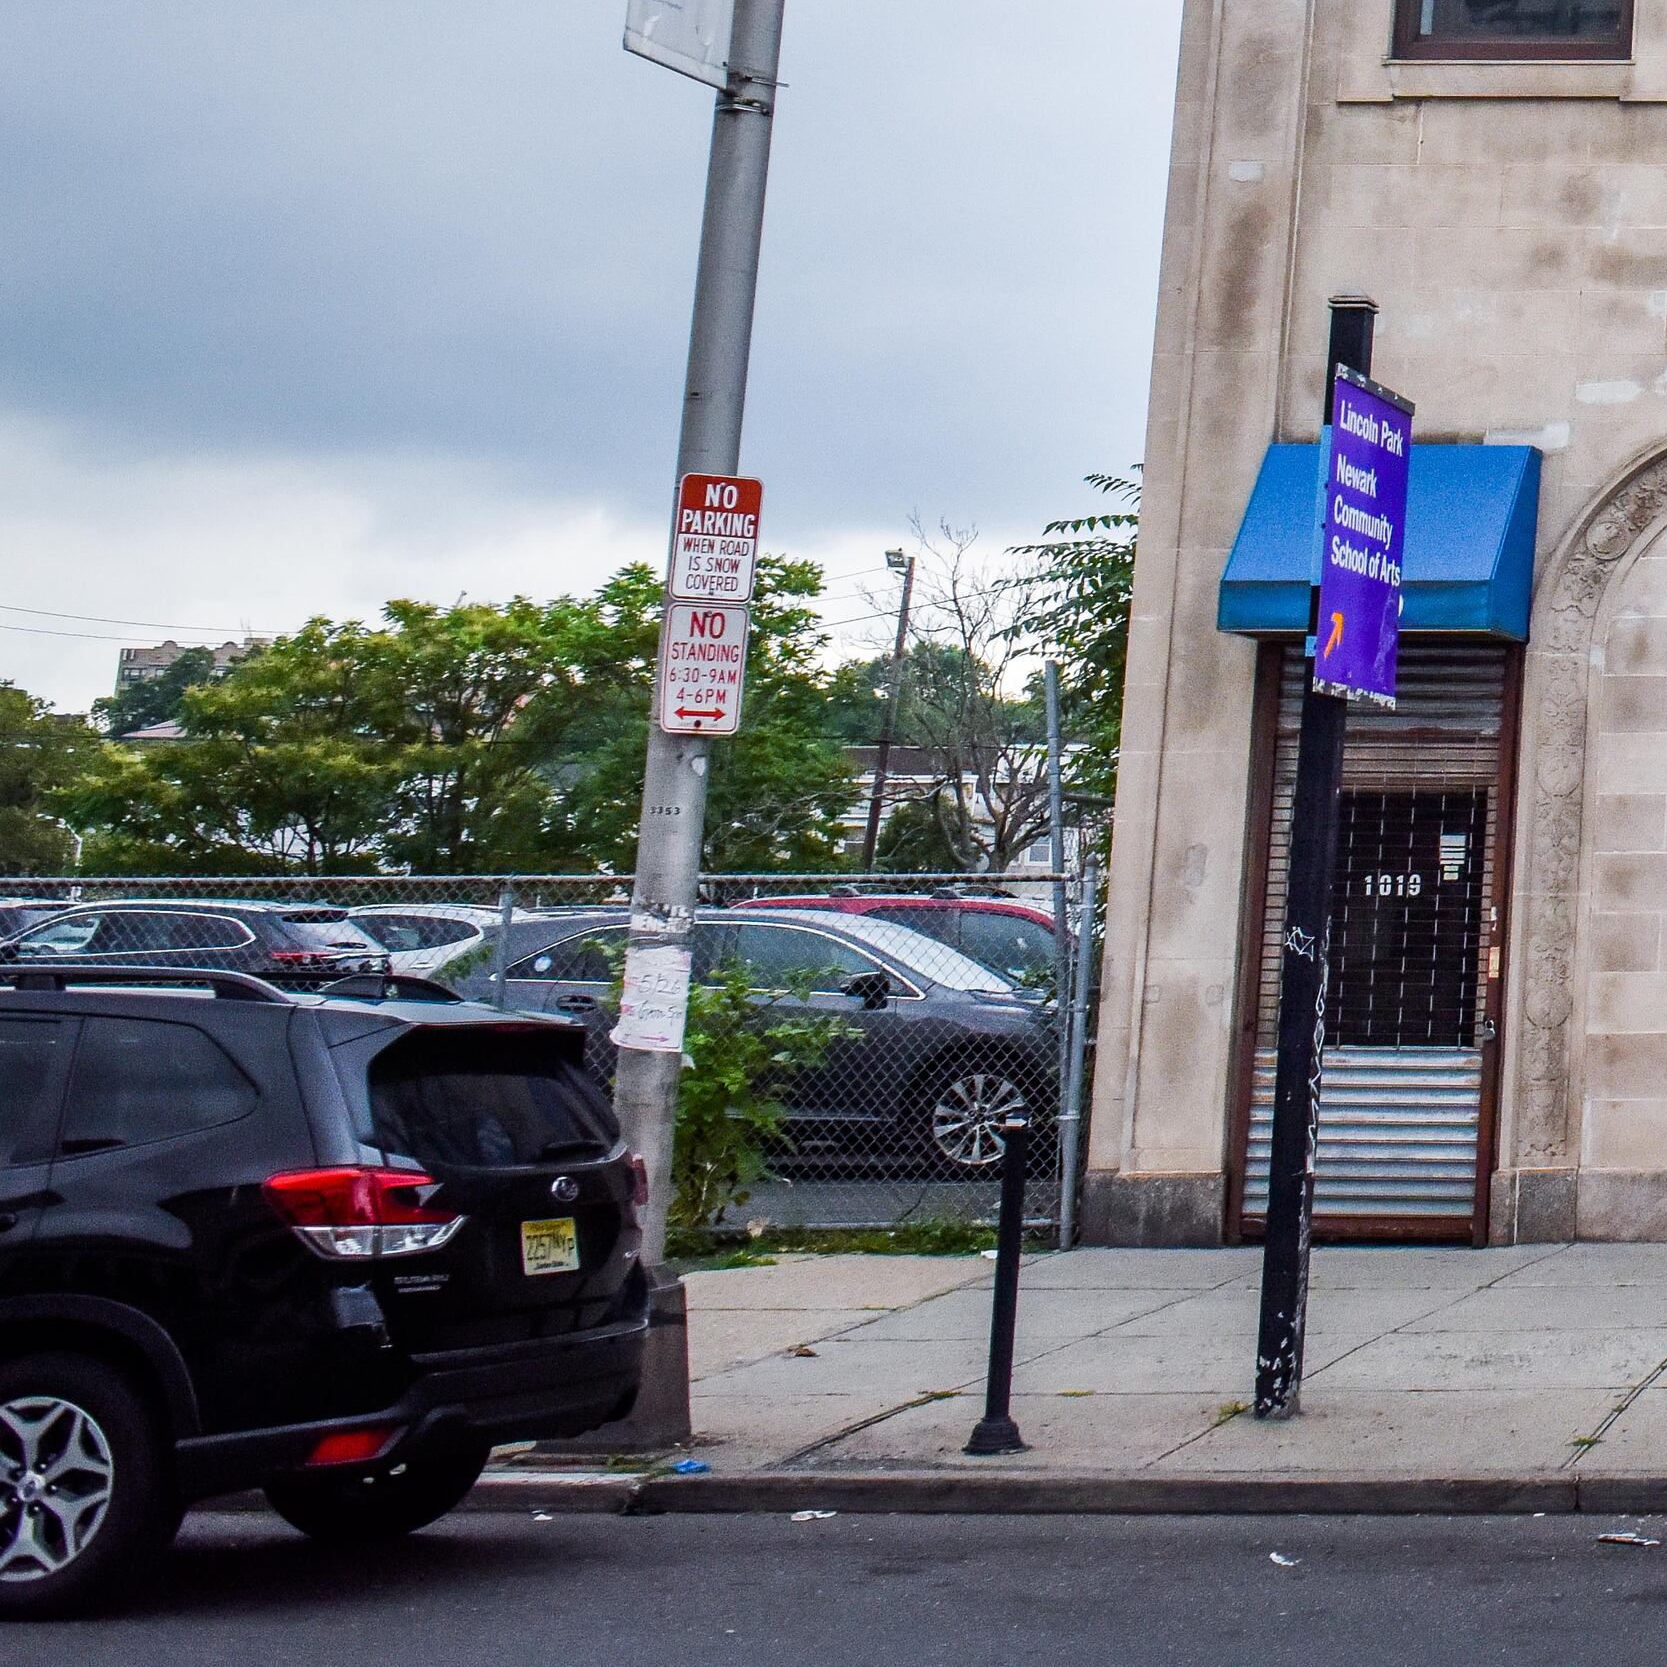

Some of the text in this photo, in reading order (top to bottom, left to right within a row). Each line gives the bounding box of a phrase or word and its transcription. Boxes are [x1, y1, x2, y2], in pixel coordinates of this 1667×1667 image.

[1340, 400, 1403, 458] Lincoln Park
[1337, 453, 1377, 498] Newark
[705, 484, 738, 509] NO
[681, 509, 755, 537] PARKING
[1334, 494, 1393, 550] Community
[683, 537, 750, 556] WHEN ROAD
[688, 556, 741, 573] IS SNOW
[1331, 535, 1401, 588] School of Arts
[685, 574, 739, 592] COVERED
[689, 611, 725, 640] NO
[671, 642, 739, 663] STANDING
[669, 667, 737, 684] 6:30-9AM
[676, 687, 727, 705] 4-6PM
[1364, 874, 1421, 896] 1019
